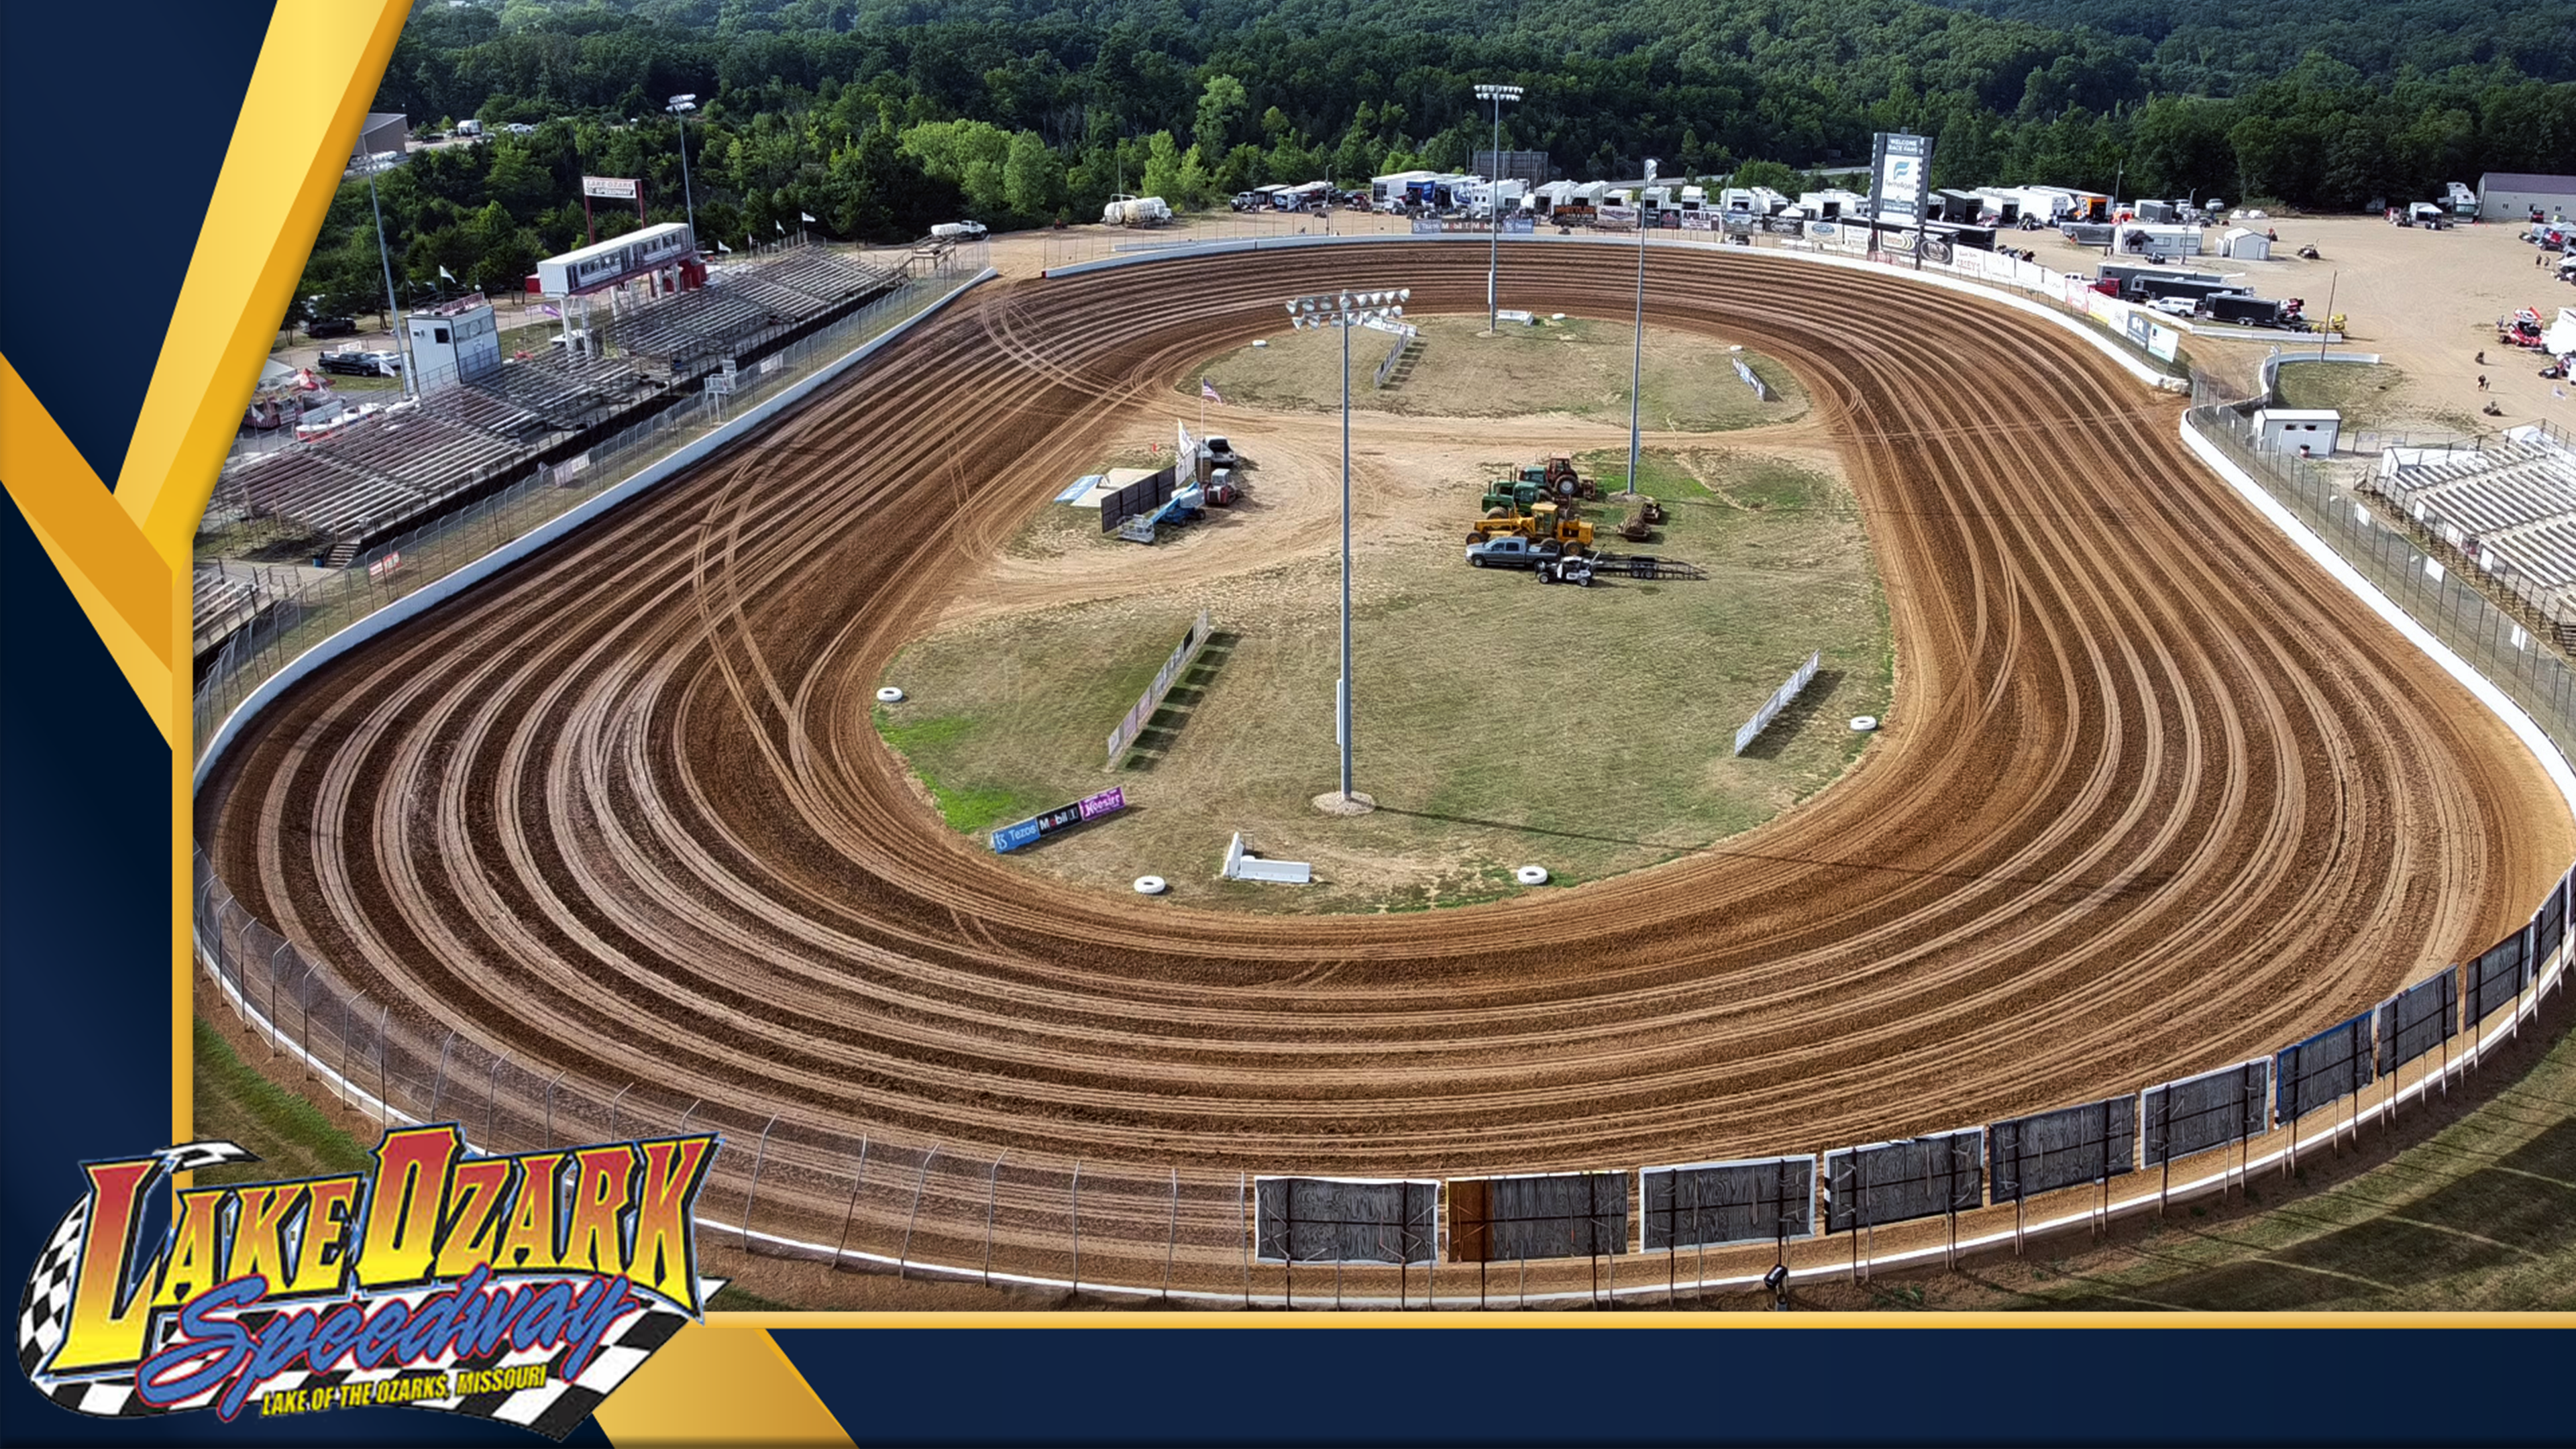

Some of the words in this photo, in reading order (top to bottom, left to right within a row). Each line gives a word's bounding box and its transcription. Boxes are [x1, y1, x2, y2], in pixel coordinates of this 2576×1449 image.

[1683, 211, 1710, 221] APOLLO
[1441, 222, 1462, 230] Mobil
[1084, 794, 1120, 816] Hoosier
[1039, 815, 1068, 830] Mobil
[1008, 824, 1036, 841] Tezos
